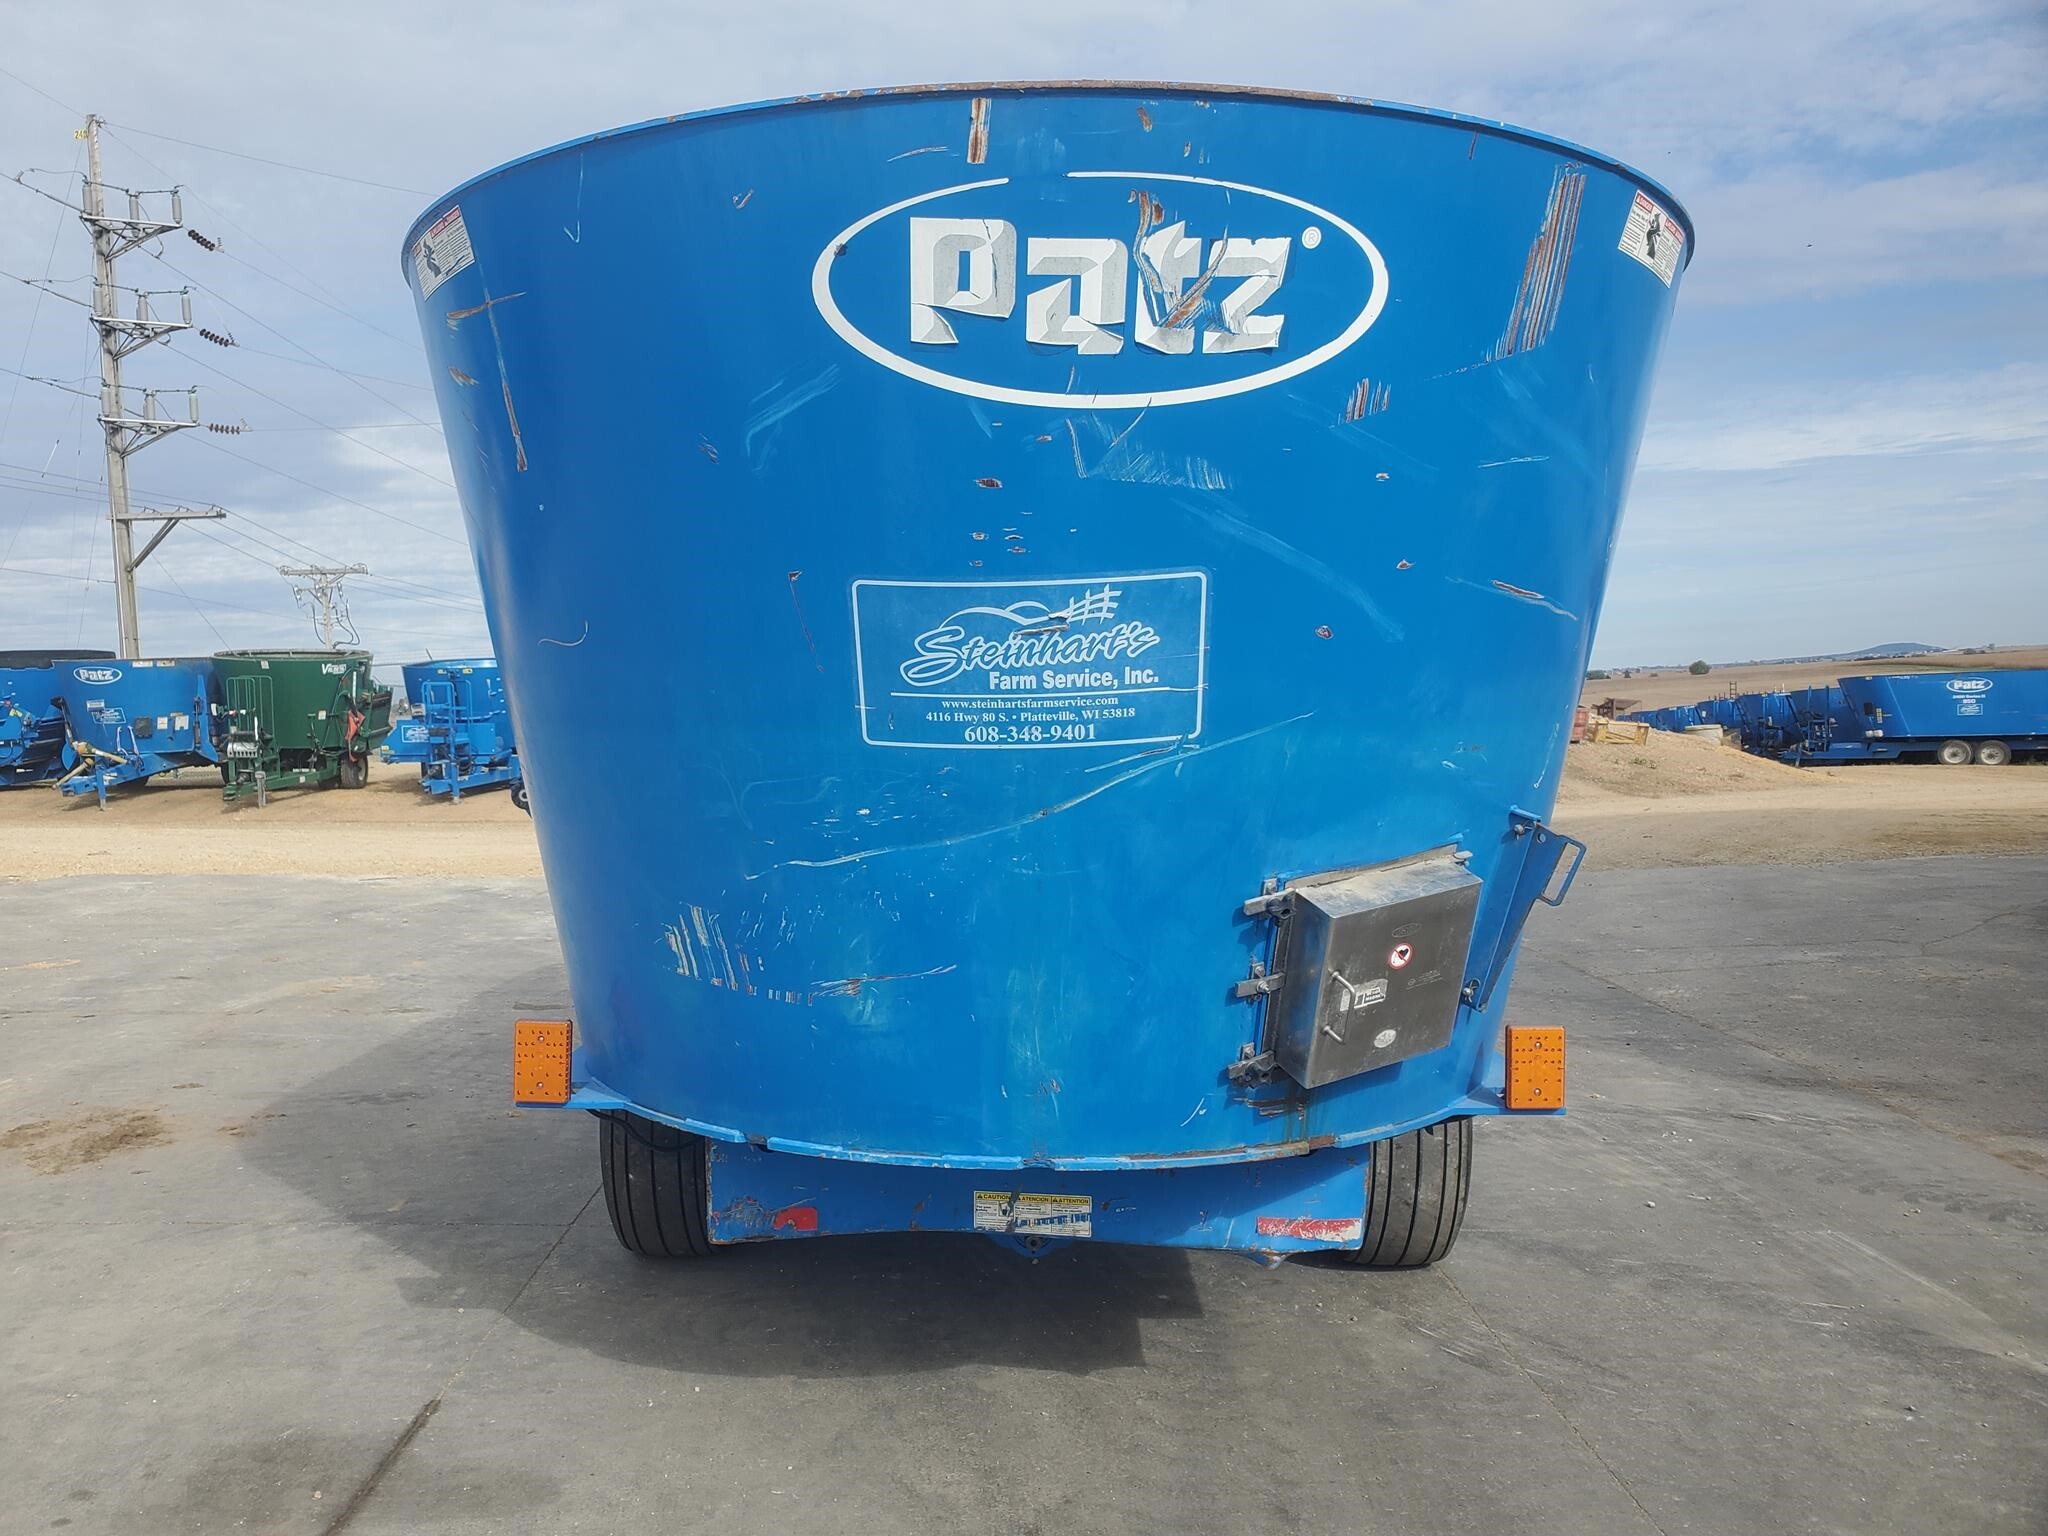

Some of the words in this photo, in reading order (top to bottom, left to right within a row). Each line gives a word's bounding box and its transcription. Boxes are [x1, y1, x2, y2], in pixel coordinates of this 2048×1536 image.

[910, 217, 1291, 354] Patz
[79, 669, 113, 680] Patz
[989, 671, 1037, 690] Farm
[1042, 668, 1118, 689] Service,
[1124, 666, 1159, 684] Inc.
[942, 697, 1119, 709] www.steinhartsfarmservice.com
[926, 712, 950, 721] 4116
[954, 712, 979, 724] Hwy
[982, 712, 996, 722] 80
[998, 712, 1009, 722] S.
[1020, 711, 1079, 722] Platteville,
[1081, 709, 1099, 720] WI
[1102, 707, 1135, 719] 53818
[964, 723, 1097, 742] 608-348-9401
